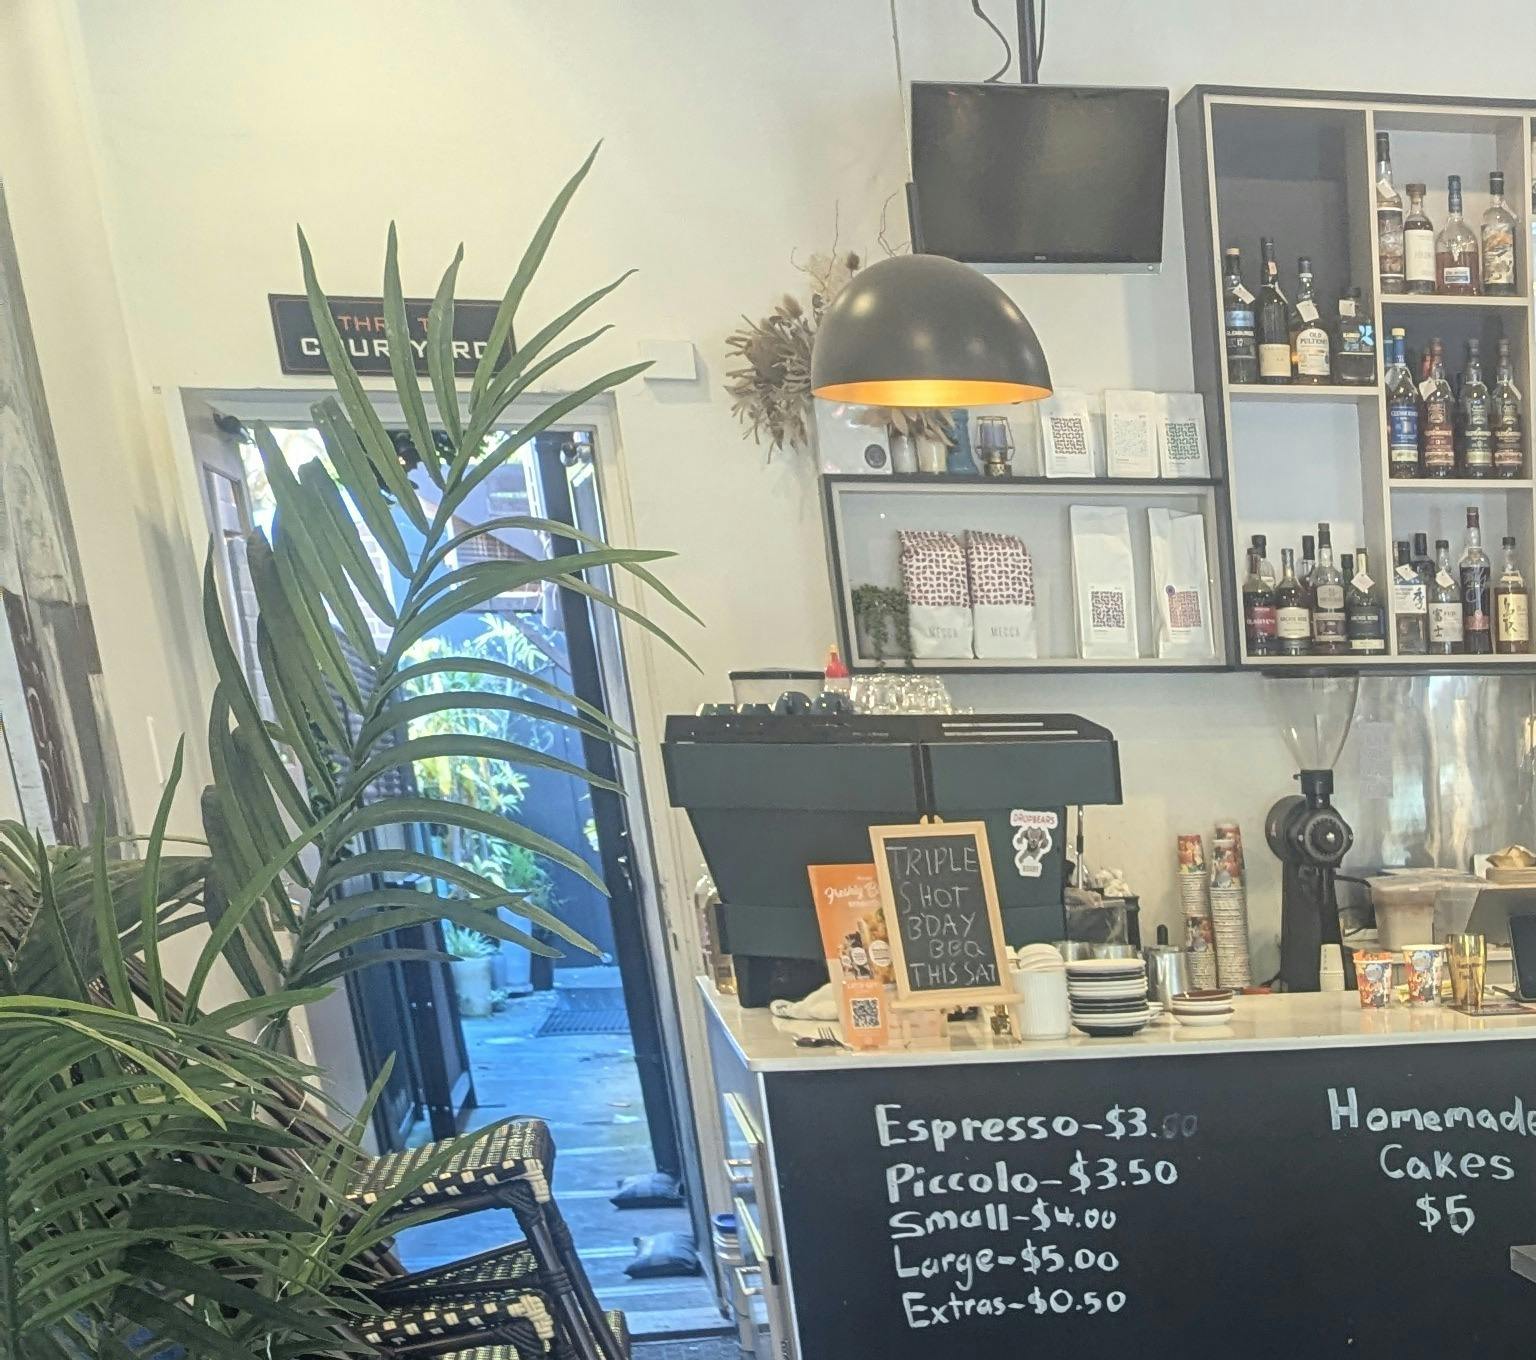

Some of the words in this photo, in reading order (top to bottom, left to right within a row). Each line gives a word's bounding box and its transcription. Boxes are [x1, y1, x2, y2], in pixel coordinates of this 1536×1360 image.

[300, 337, 495, 361] CURYRD
[886, 846, 979, 878] TRIPLE
[900, 881, 970, 914] SHOT
[908, 912, 976, 940] B'DAY
[909, 962, 958, 987] THIS
[964, 961, 996, 985] SAT
[1380, 1143, 1515, 1181] Cakes
[1416, 1193, 1475, 1236] $5
